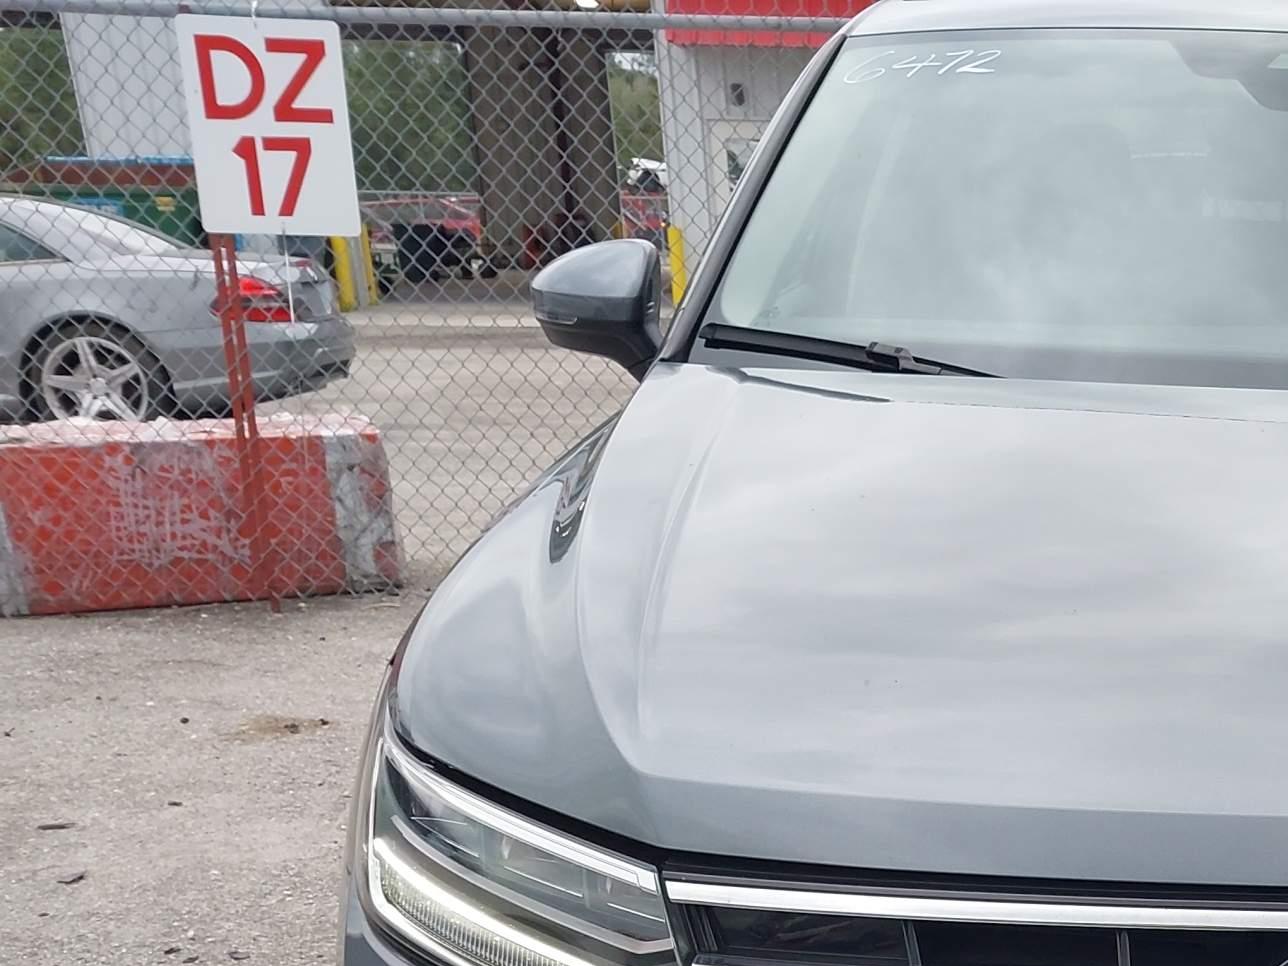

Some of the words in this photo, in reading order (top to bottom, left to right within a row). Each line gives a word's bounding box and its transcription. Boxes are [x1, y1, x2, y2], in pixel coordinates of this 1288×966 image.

[193, 34, 334, 124] DZ
[843, 50, 1001, 84] 6472
[231, 136, 312, 216] 17
